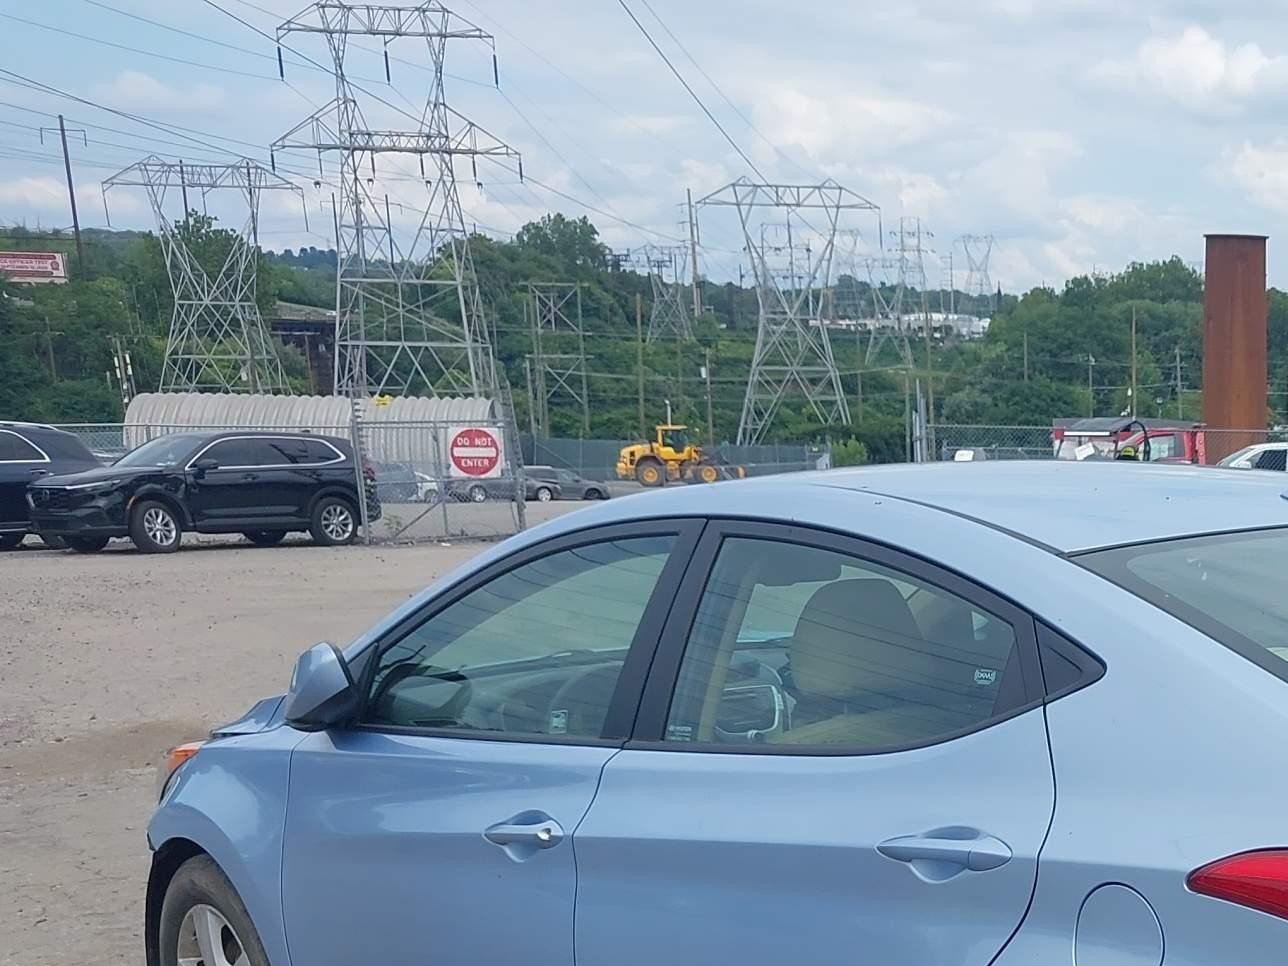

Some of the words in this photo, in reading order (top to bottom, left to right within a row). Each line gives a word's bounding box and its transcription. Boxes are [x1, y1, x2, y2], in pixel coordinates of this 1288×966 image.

[457, 437, 470, 446] DO
[474, 437, 492, 446] NOT
[461, 459, 489, 468] ENTER
